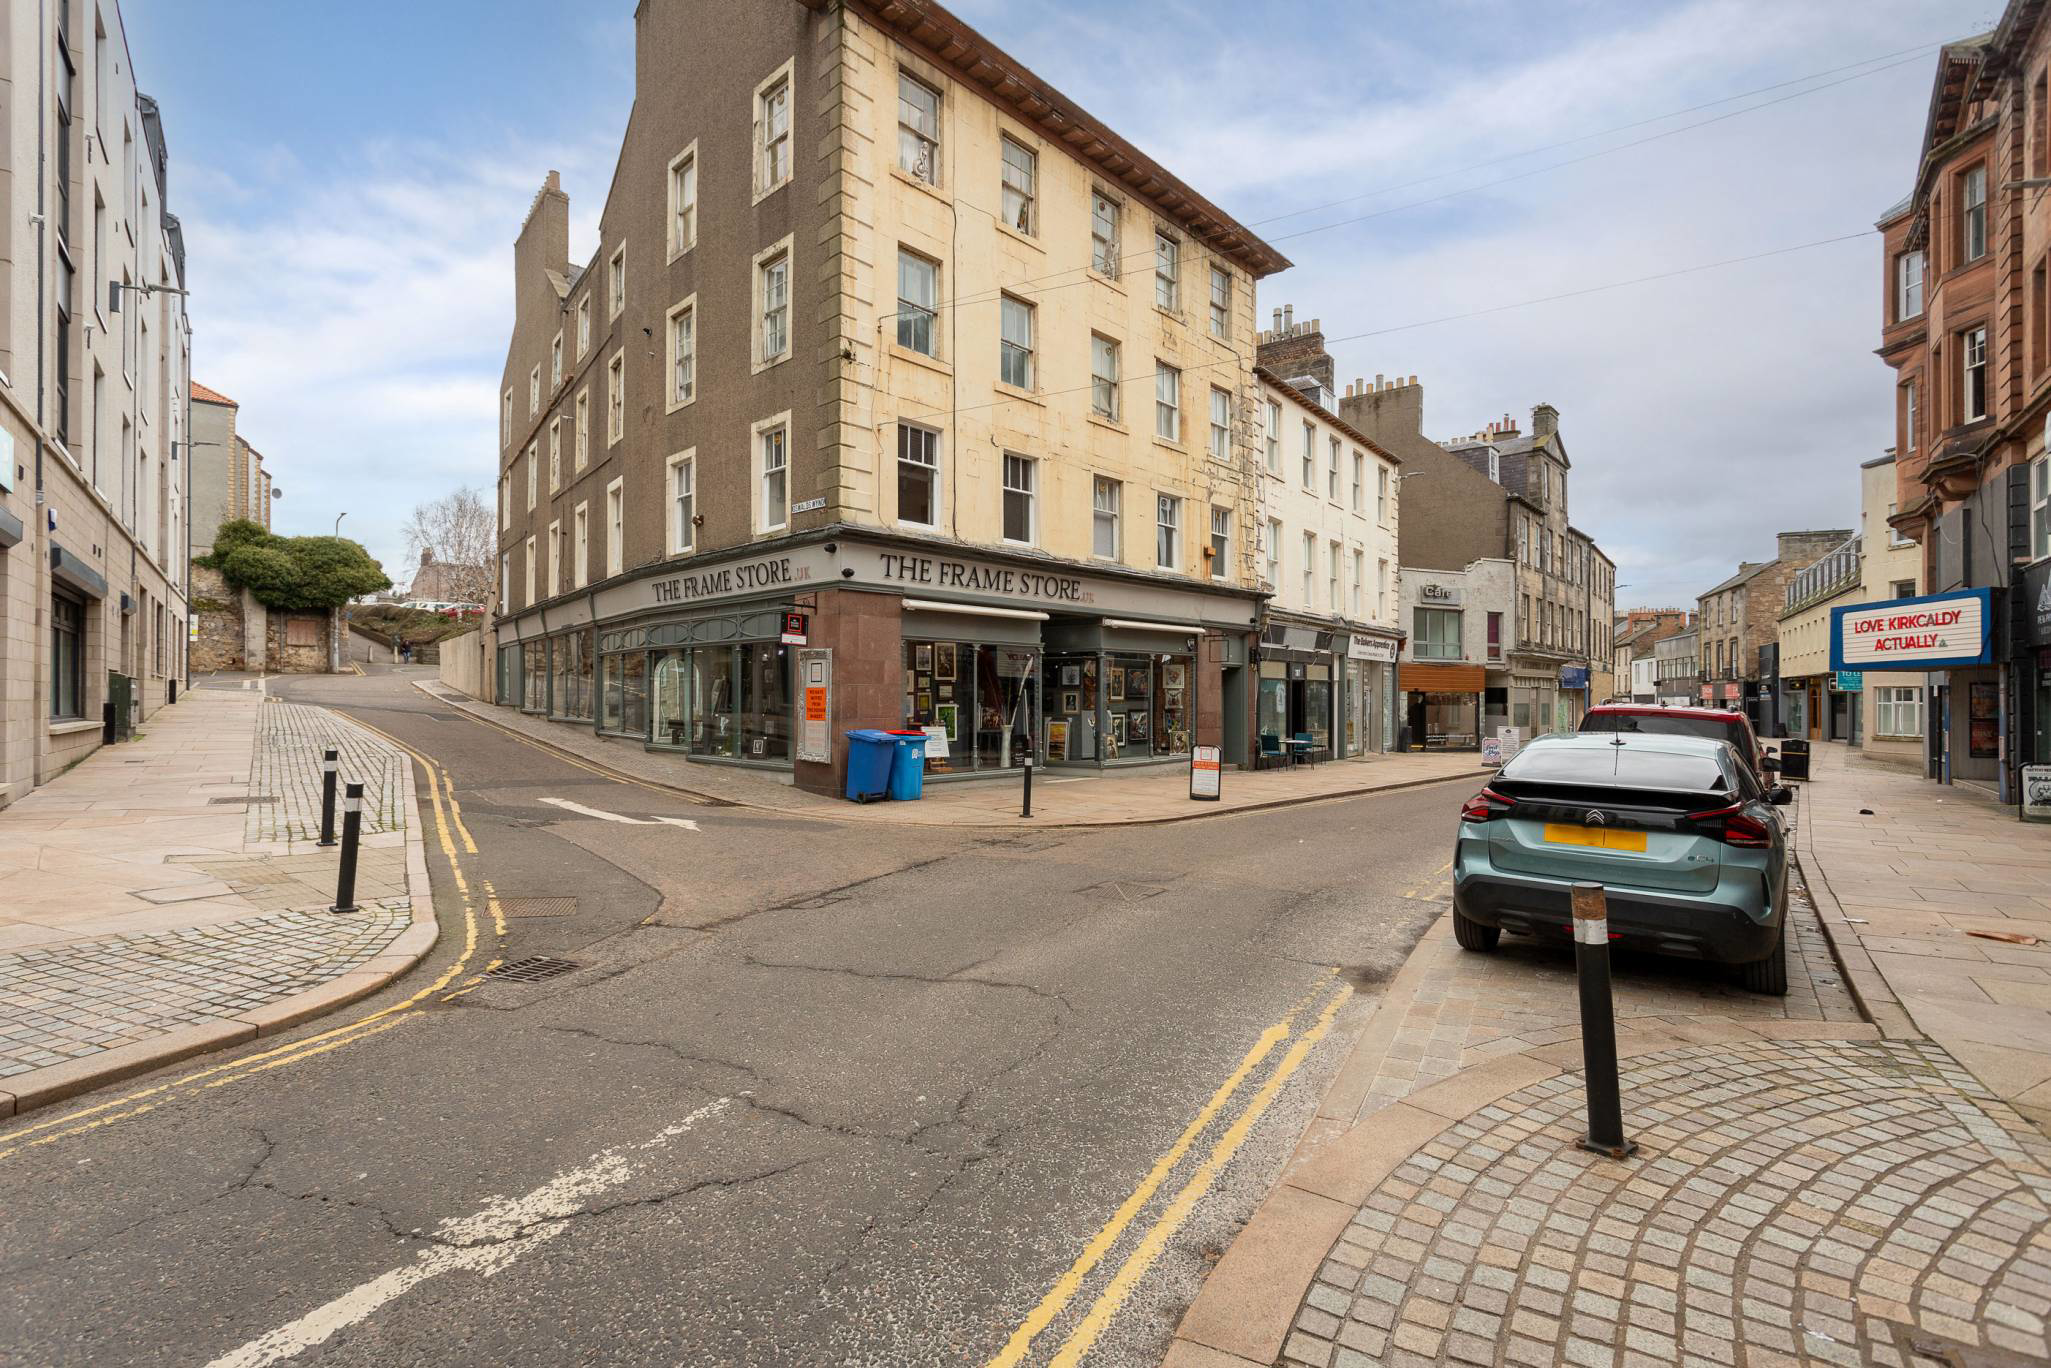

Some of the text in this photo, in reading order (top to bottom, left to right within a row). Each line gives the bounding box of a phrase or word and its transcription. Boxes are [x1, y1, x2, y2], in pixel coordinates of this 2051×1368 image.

[652, 578, 681, 602] THE
[684, 570, 732, 598] FRAME
[880, 554, 932, 583] THE
[940, 562, 1014, 593] FRAME
[1854, 609, 1962, 634] LOVE KIRKCALDY
[1874, 633, 1938, 652] ACTUALLY
